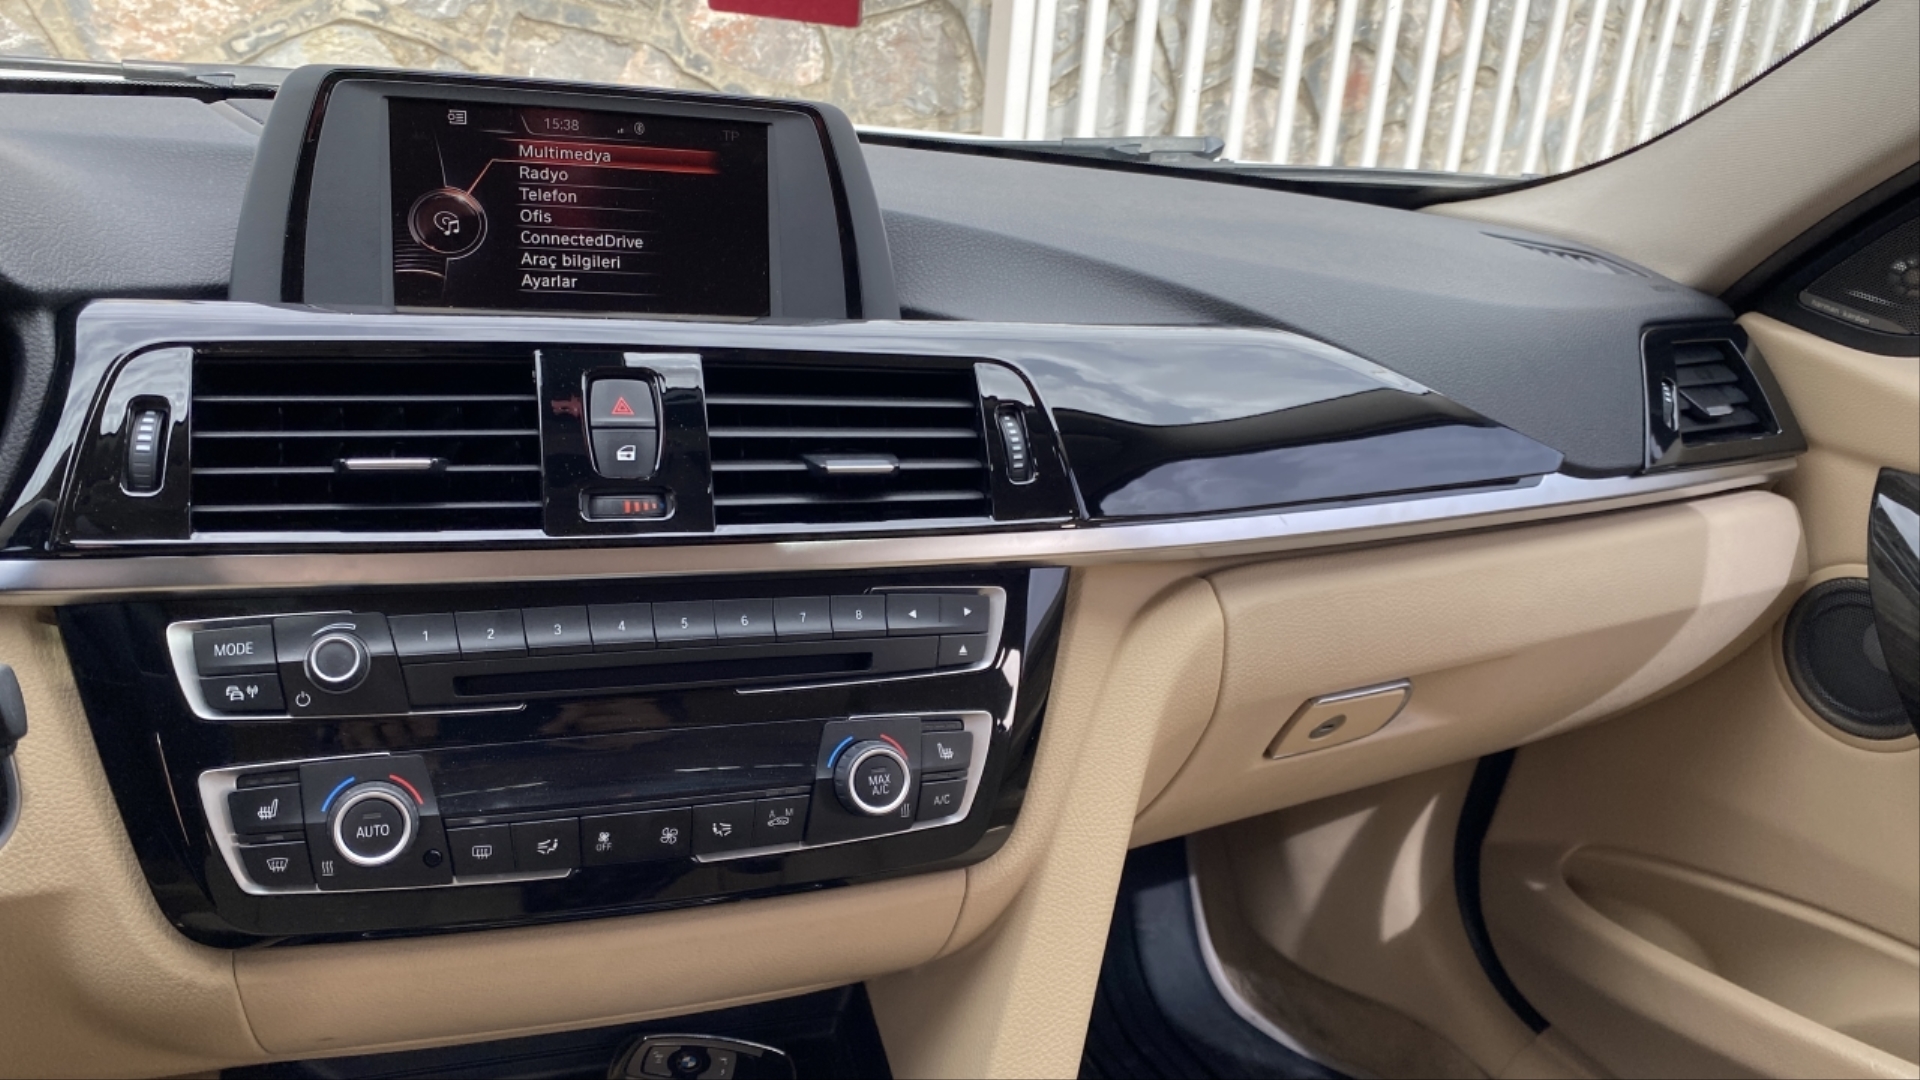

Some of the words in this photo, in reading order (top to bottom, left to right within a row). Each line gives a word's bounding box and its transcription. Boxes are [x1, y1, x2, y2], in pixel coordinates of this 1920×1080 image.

[543, 117, 580, 131] 15:38
[518, 144, 612, 163] Multimedya
[518, 166, 569, 183] Radyo
[518, 187, 578, 203] Telefon
[520, 209, 552, 224] Ofis
[520, 231, 644, 249] ConnectedDrive
[521, 252, 557, 269] Araç
[561, 253, 621, 270] bilgileri
[521, 274, 578, 290] Ayarlar
[740, 614, 749, 626] 6
[799, 611, 807, 623] 7
[855, 609, 863, 620] 8
[617, 620, 626, 631] 4
[680, 617, 689, 629] 5
[421, 630, 429, 641] 1
[486, 628, 495, 640] 2
[553, 624, 562, 636] 3
[213, 641, 254, 657] MODE
[868, 773, 892, 787] MAX
[872, 783, 890, 796] A/C
[933, 794, 951, 806] A/C
[785, 807, 794, 816] M
[355, 823, 390, 839] AUTO
[595, 842, 612, 852] OFF
